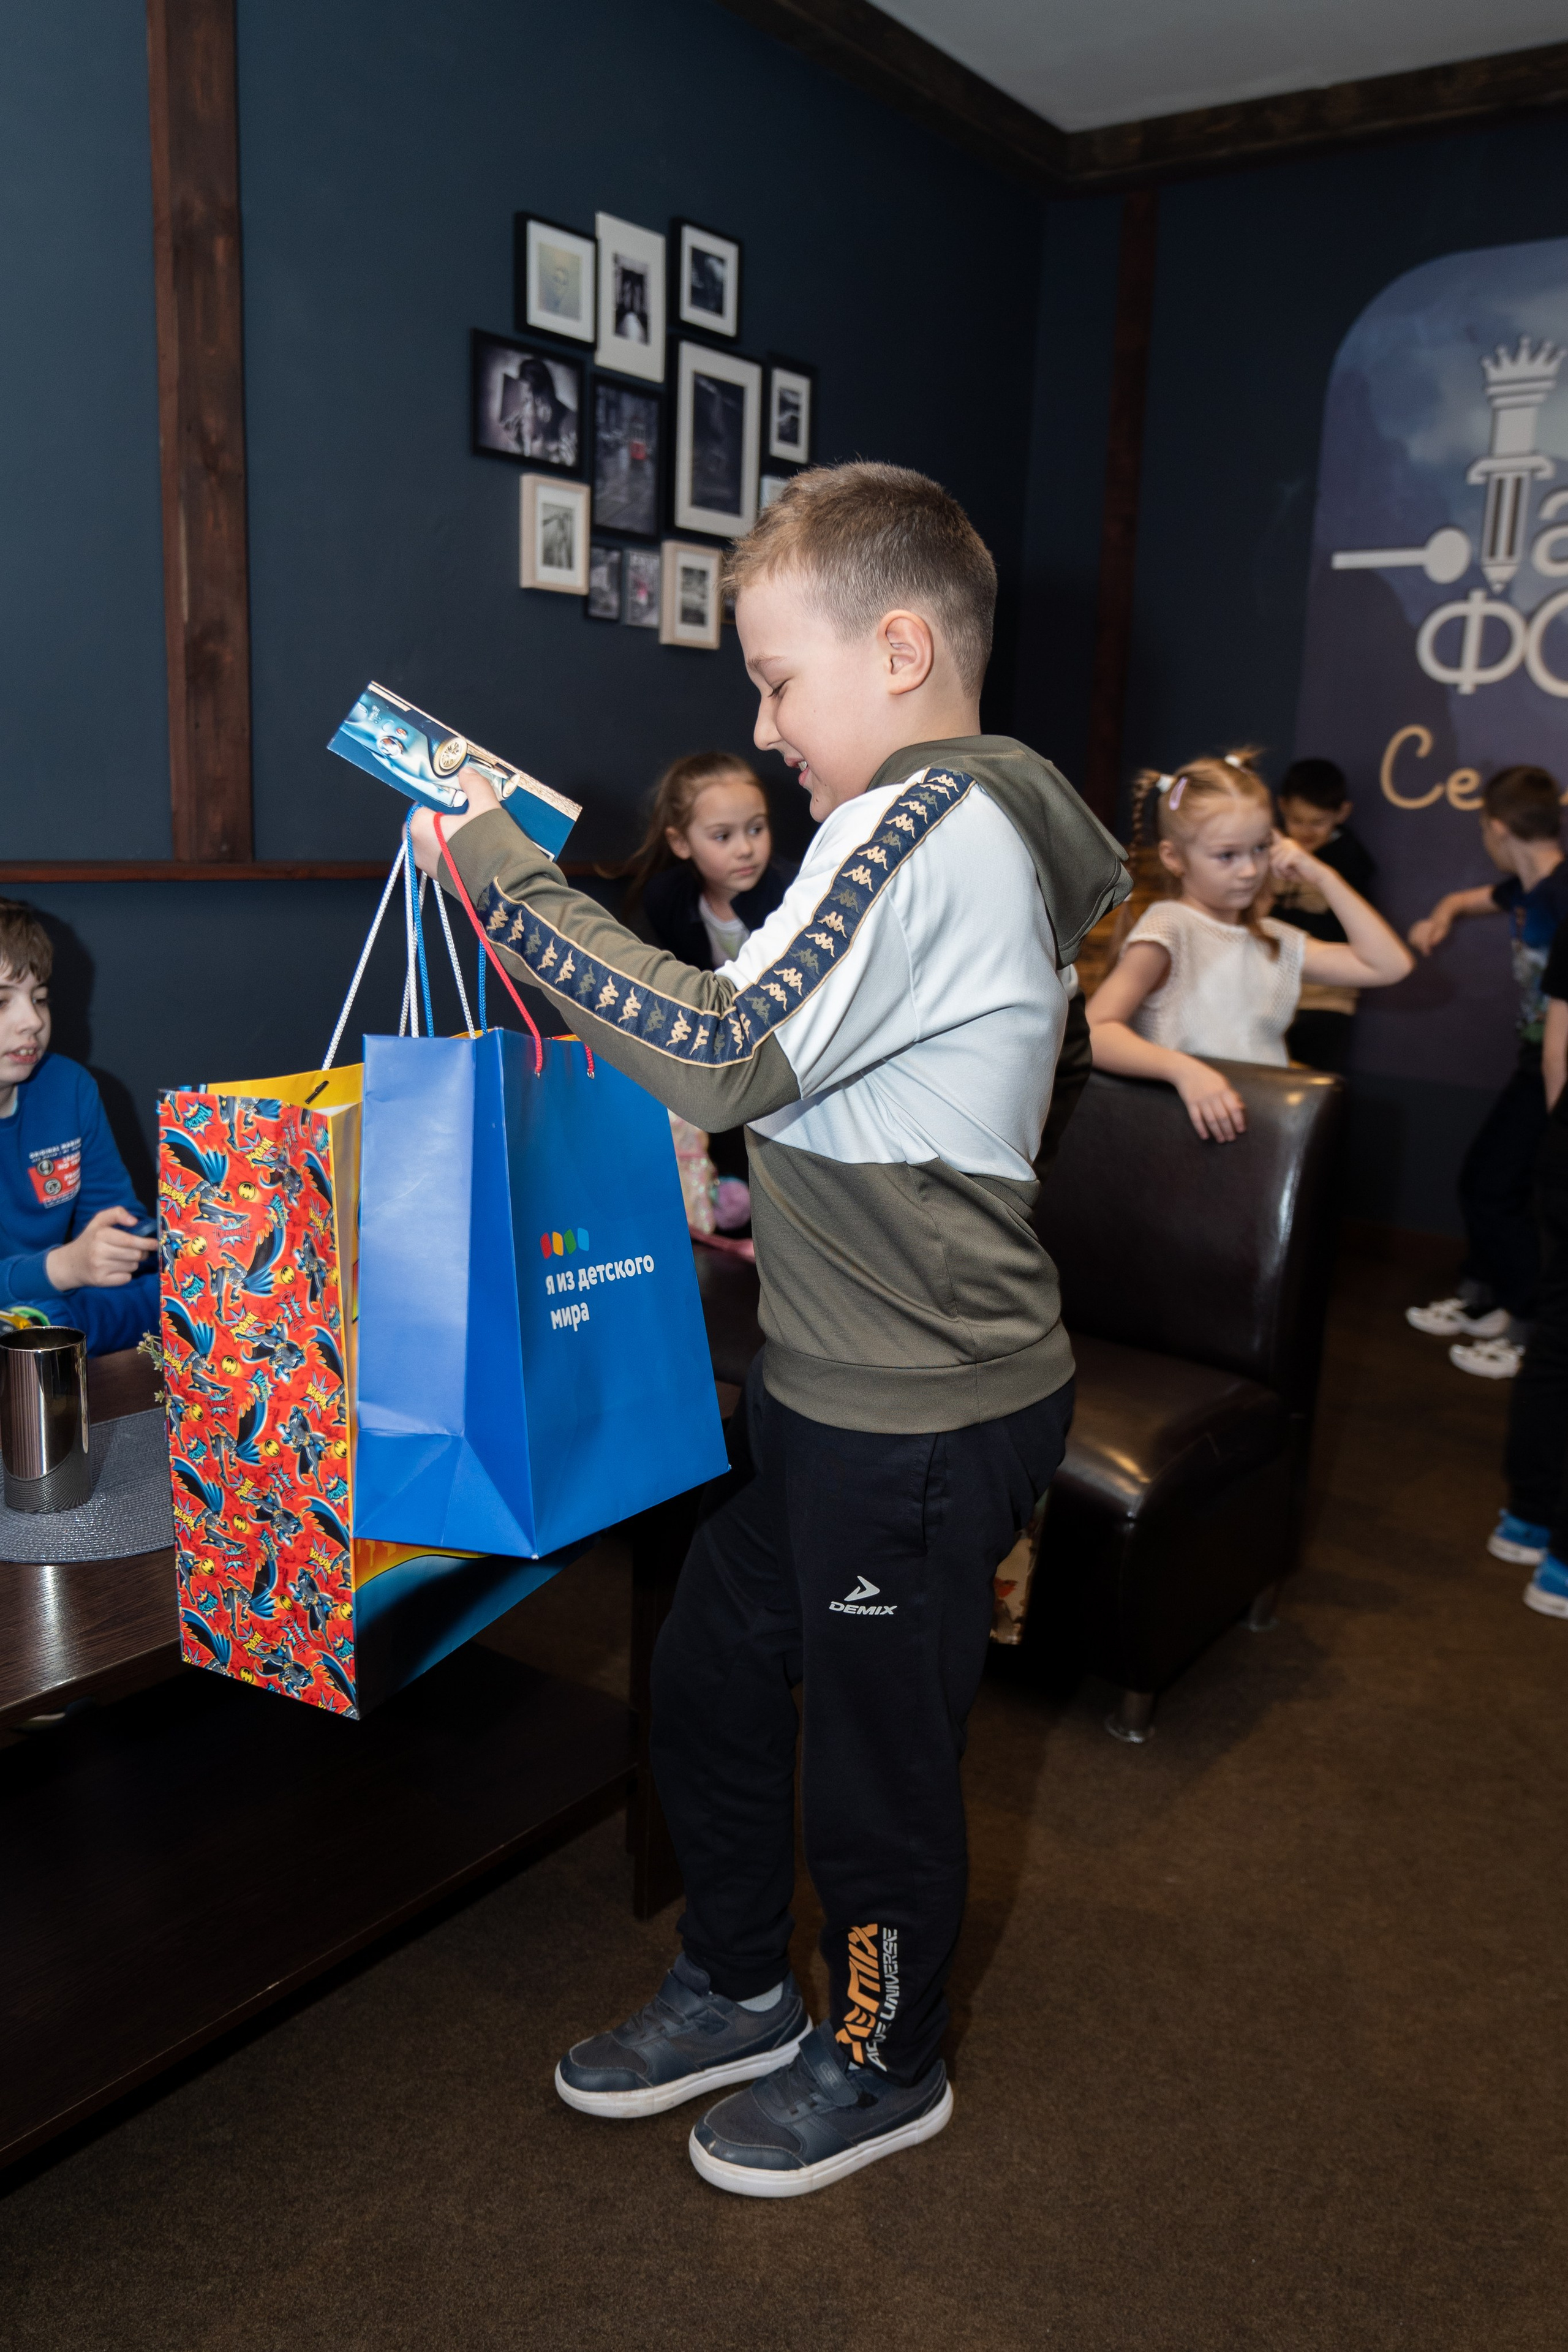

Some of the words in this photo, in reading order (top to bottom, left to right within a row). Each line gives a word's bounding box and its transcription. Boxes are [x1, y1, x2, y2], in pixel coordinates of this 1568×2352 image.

[556, 1271, 575, 1292] из
[578, 1254, 655, 1291] детского
[550, 1302, 590, 1332] мира
[829, 1601, 898, 1615] DEMIX
[880, 1928, 900, 2021] UNIVERSE
